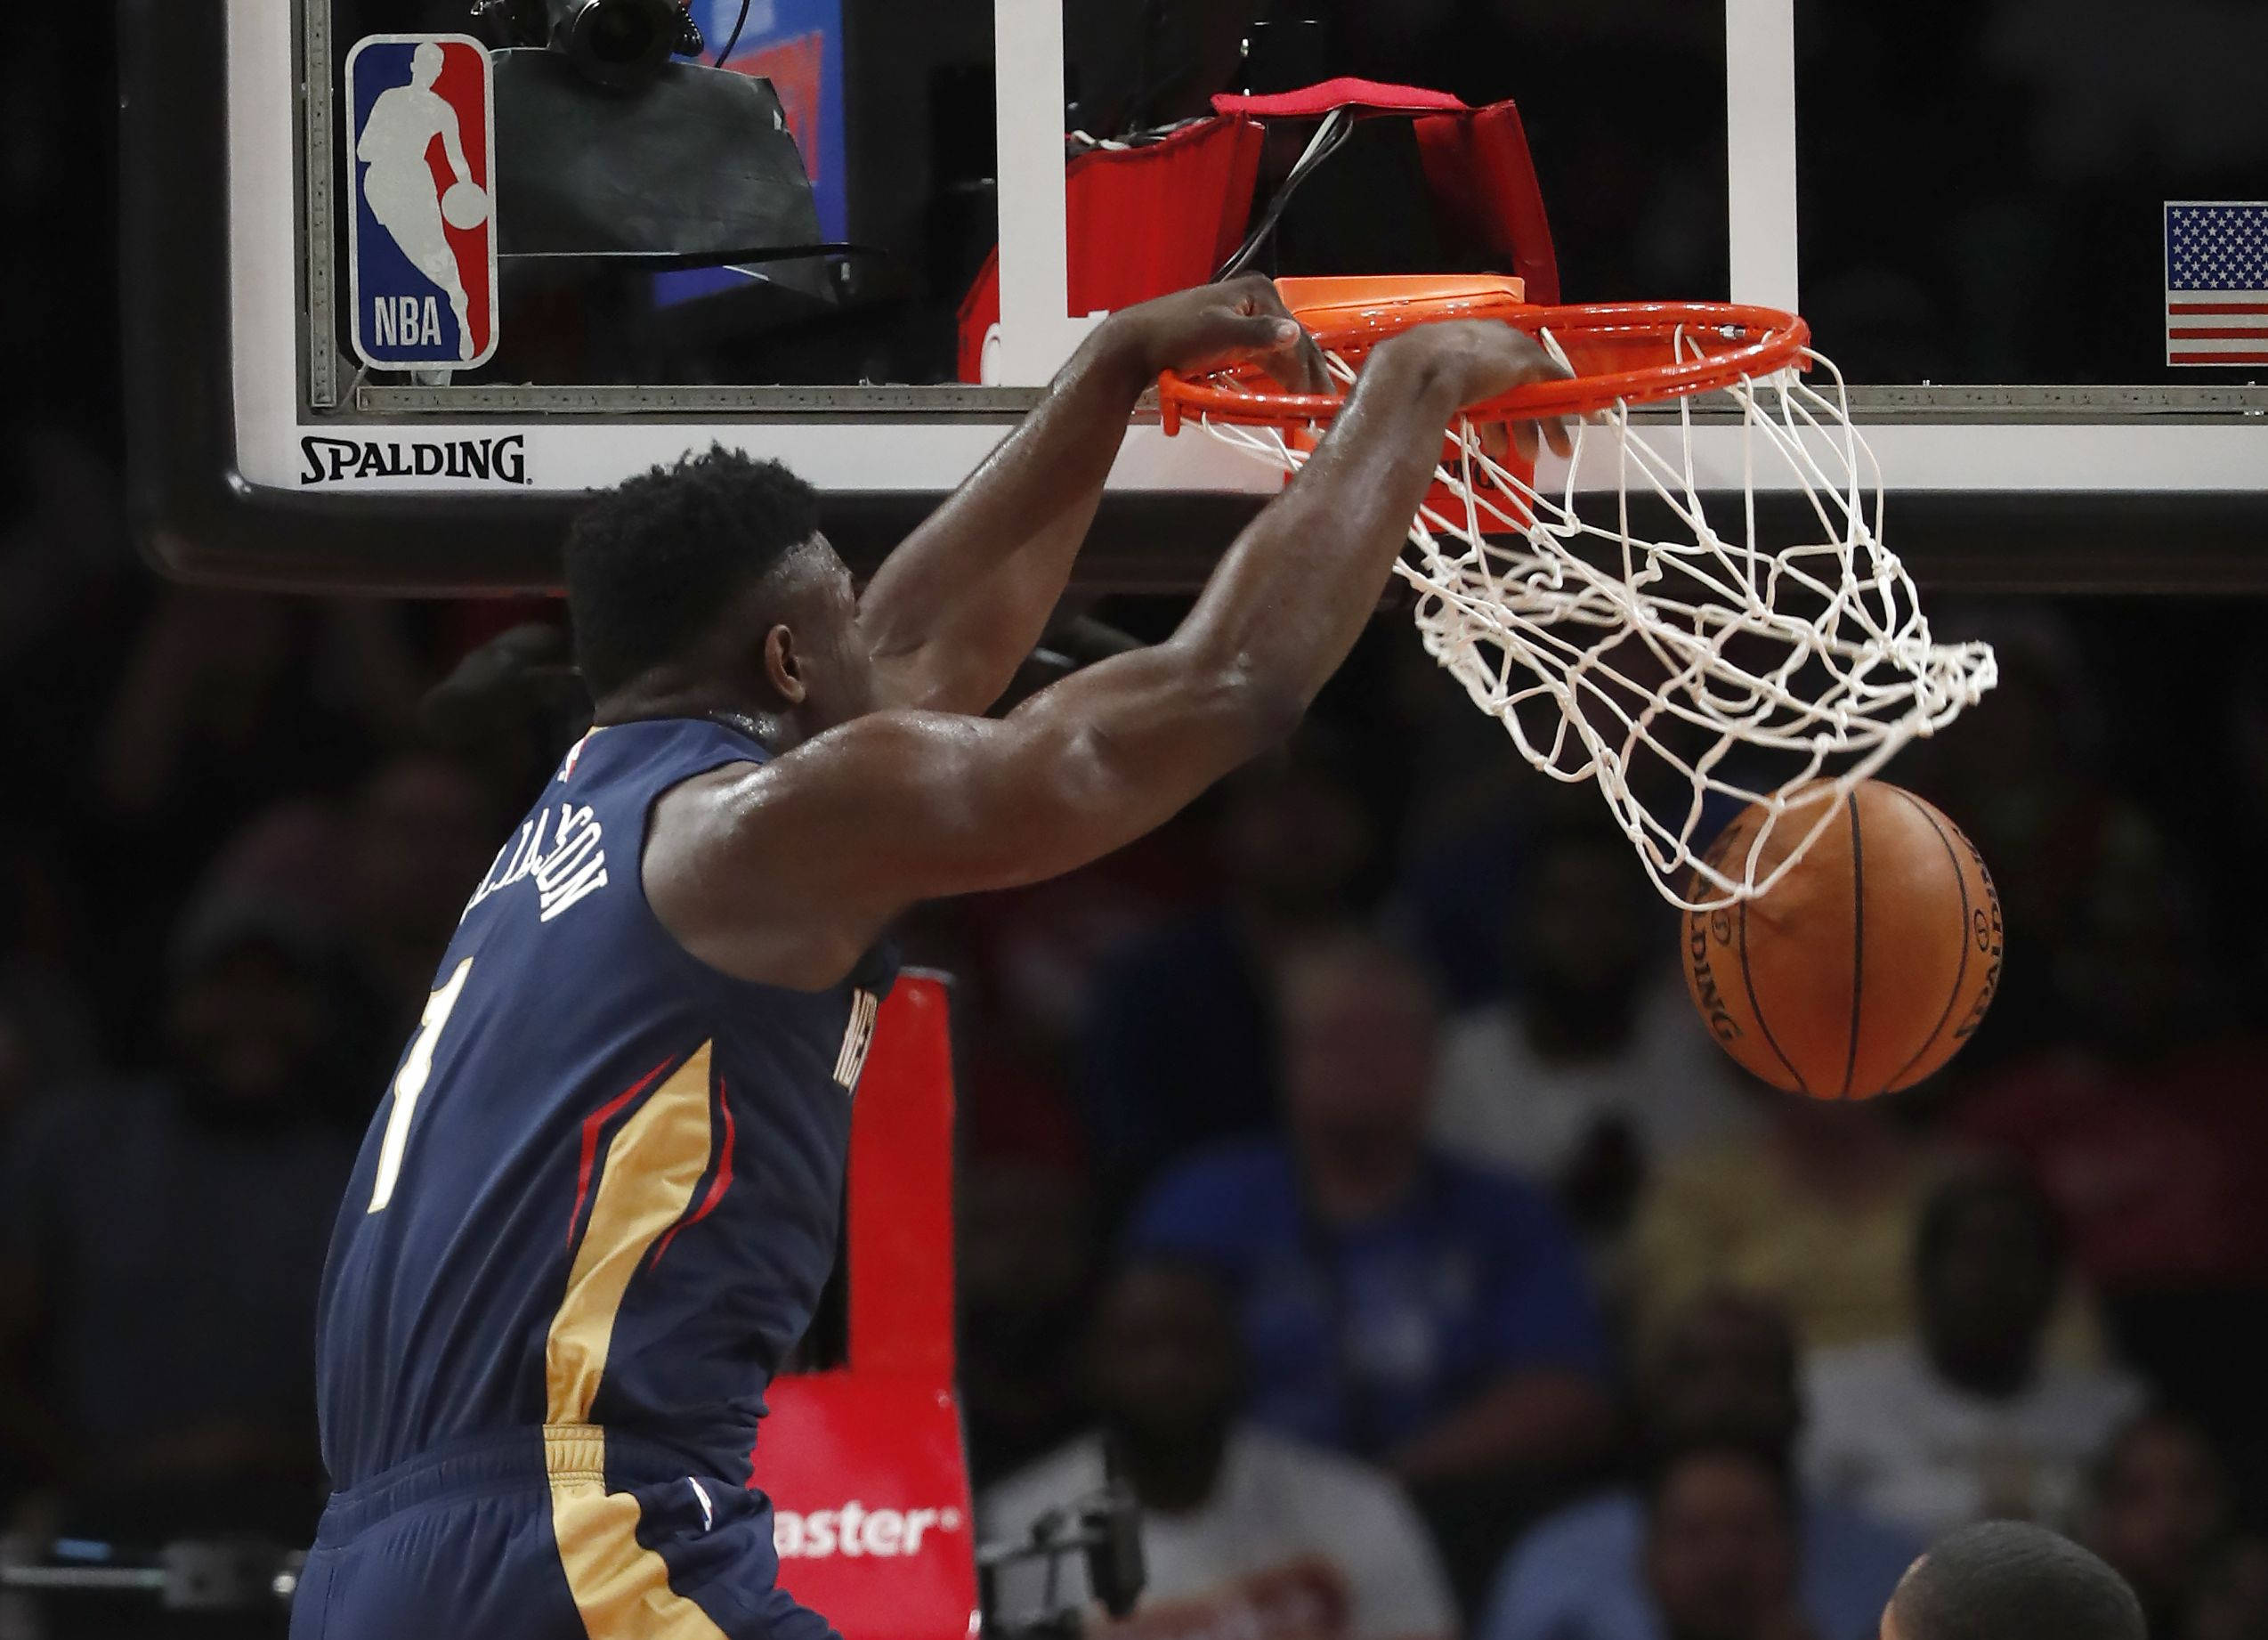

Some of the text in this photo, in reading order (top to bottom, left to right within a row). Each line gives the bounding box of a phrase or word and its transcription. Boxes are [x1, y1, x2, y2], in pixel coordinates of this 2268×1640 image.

[375, 296, 441, 346] NBA
[301, 434, 525, 484] SPALDING
[367, 955, 474, 1214] 1
[773, 1499, 938, 1558] aster
